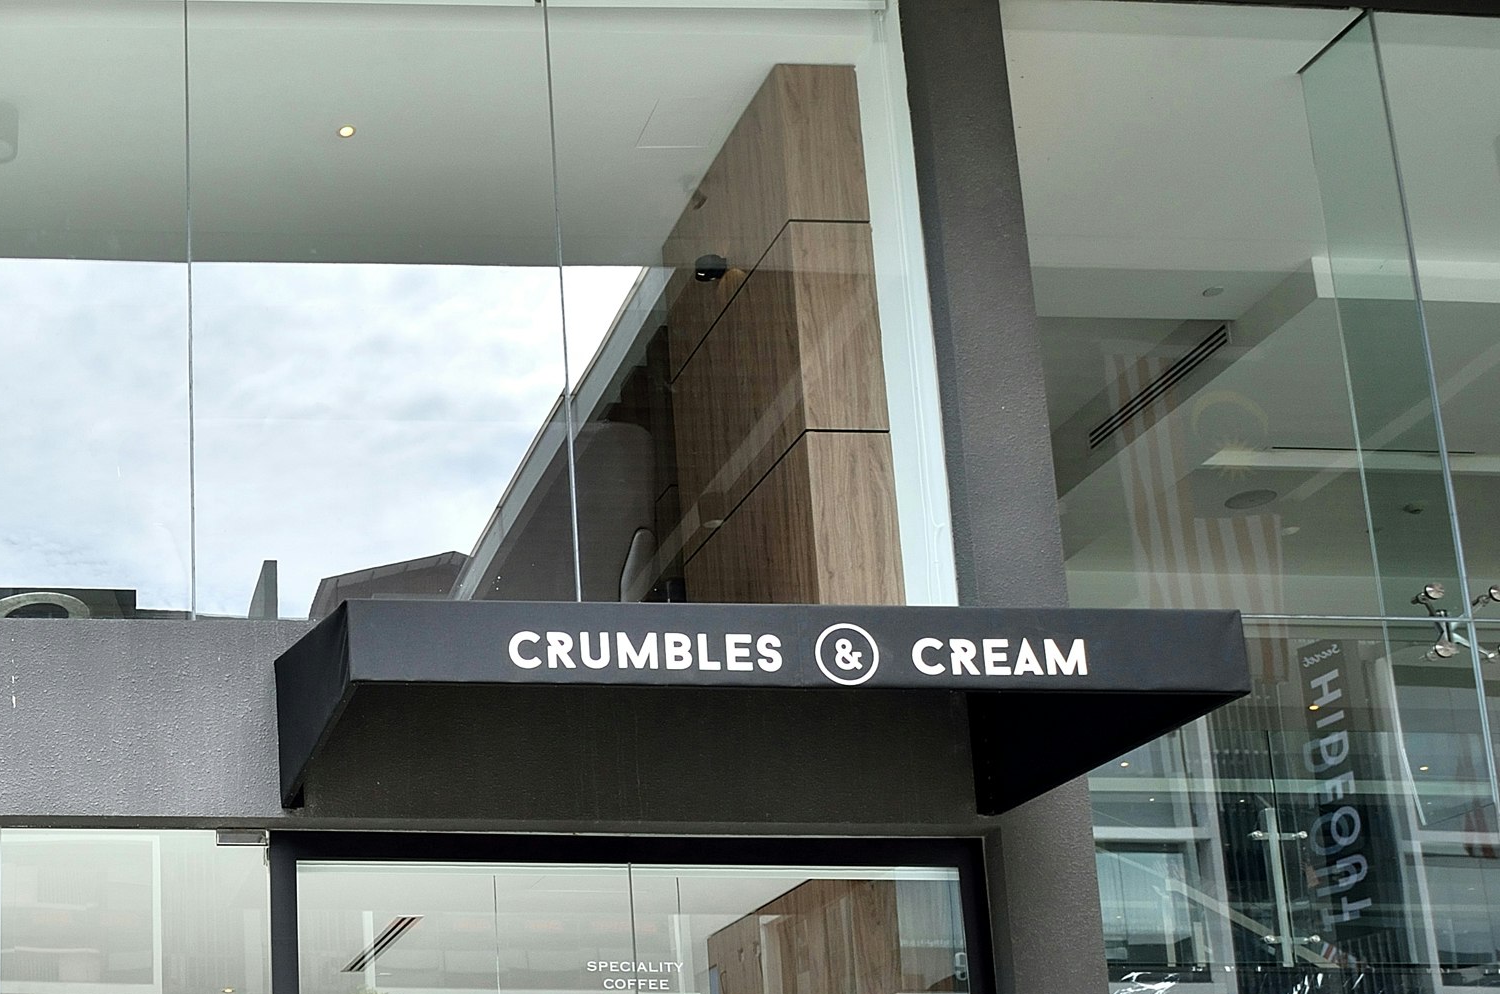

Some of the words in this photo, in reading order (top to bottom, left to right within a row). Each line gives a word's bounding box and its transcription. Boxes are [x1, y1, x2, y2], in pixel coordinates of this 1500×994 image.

[508, 630, 783, 673] CRUMBLES
[911, 637, 1089, 677] CREAM
[586, 960, 684, 973] SPECIALITY
[603, 978, 670, 990] COFFEE
